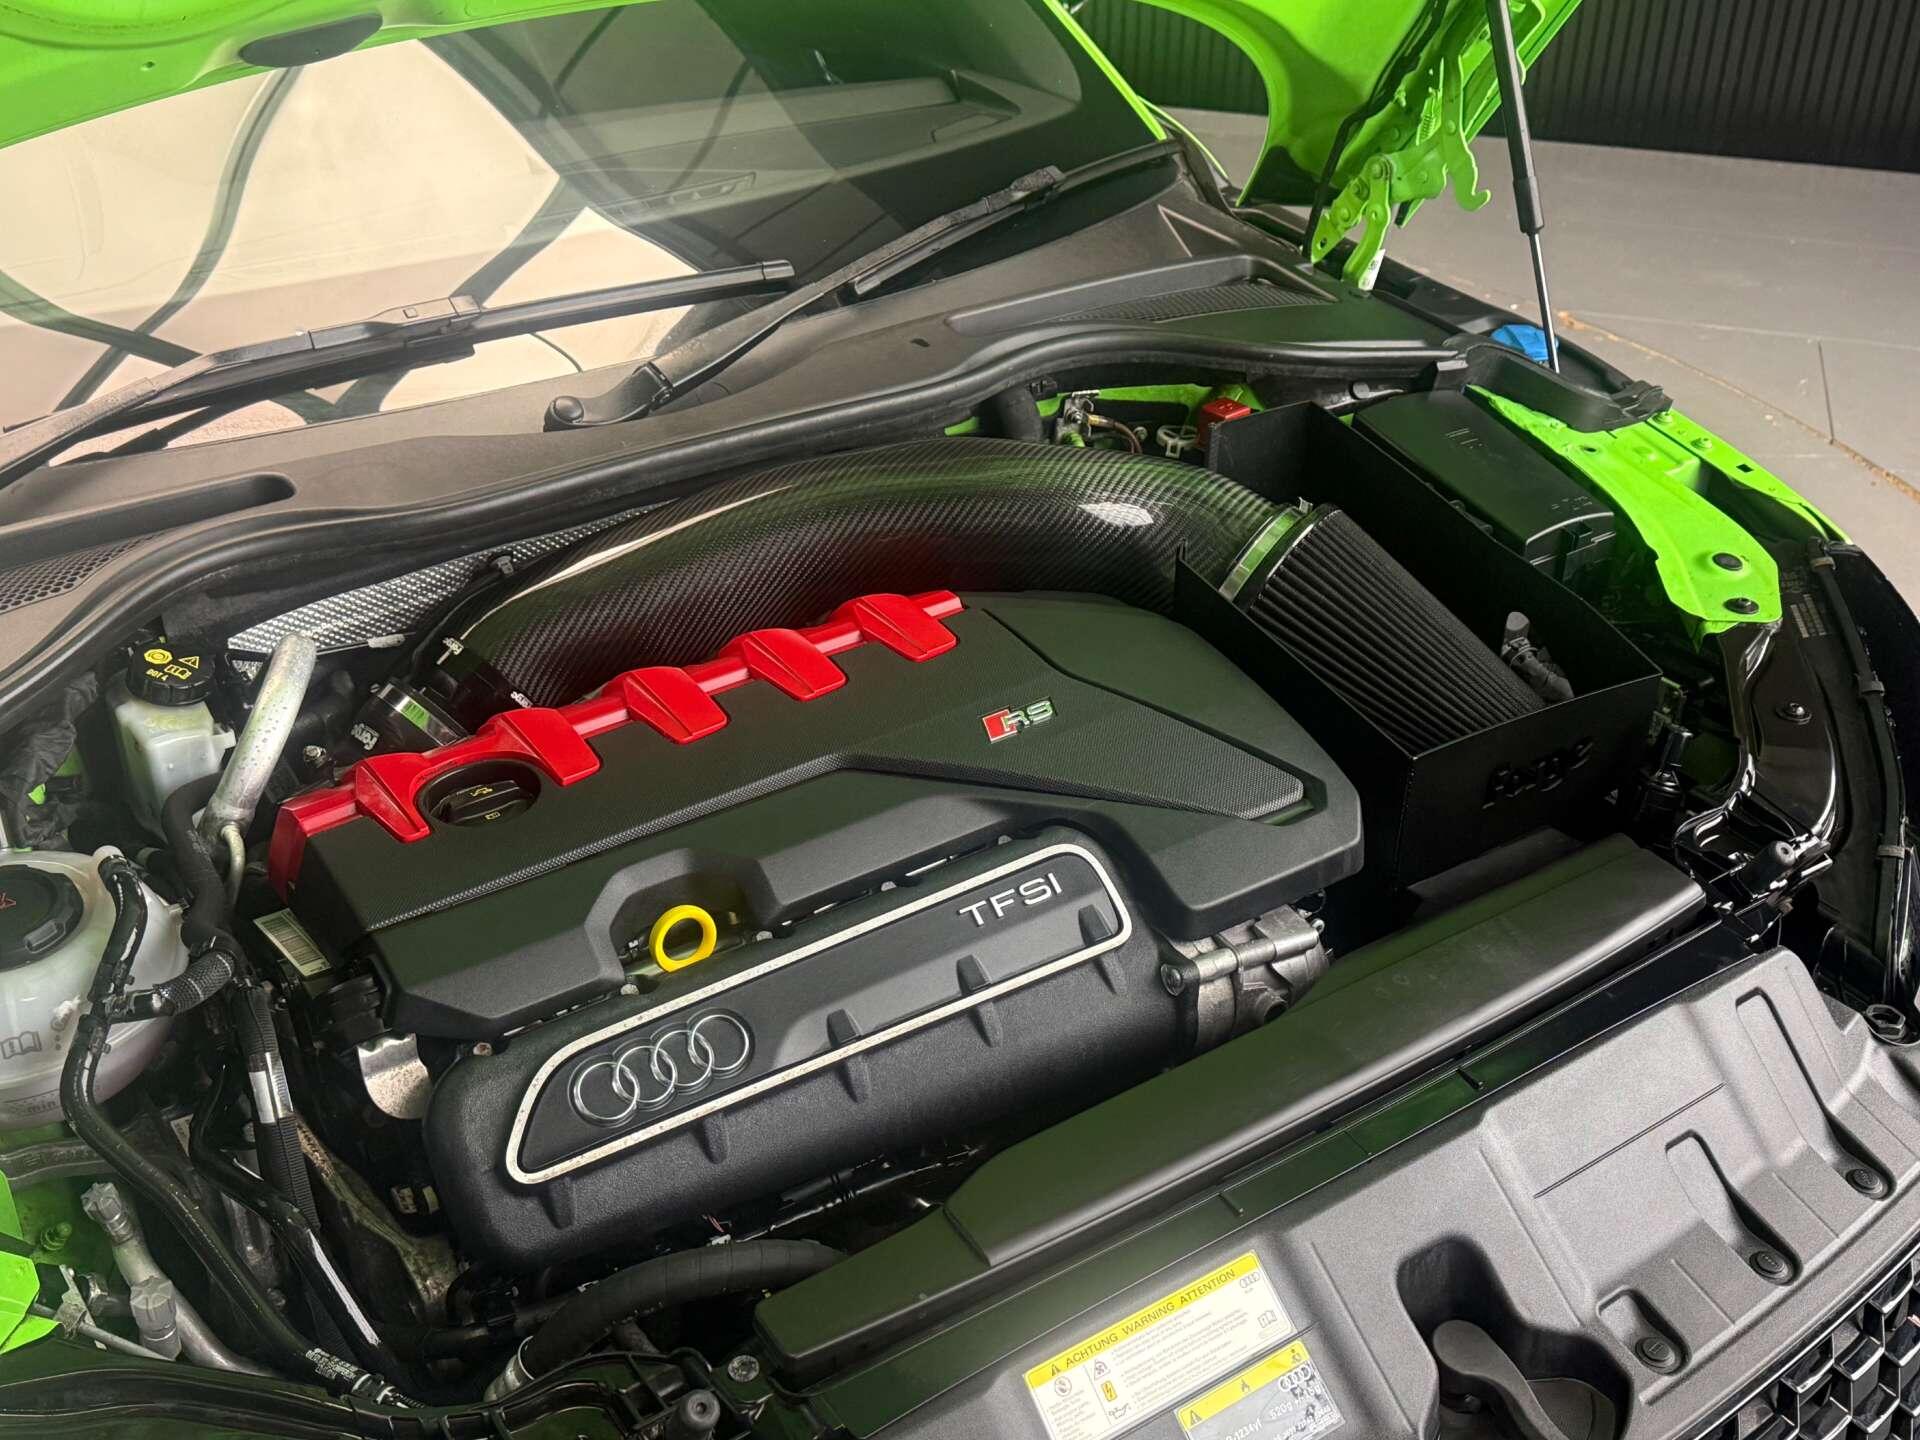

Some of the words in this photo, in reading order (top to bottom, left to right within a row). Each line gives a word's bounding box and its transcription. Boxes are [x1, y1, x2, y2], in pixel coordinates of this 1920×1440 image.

[999, 700, 1053, 732] RS
[958, 872, 1063, 927] TFSI
[27, 1099, 56, 1114] min
[1064, 1333, 1119, 1369] ACHTUNG
[1123, 1301, 1175, 1337] WARNING
[1179, 1268, 1236, 1305] ATTENTION
[1269, 1401, 1294, 1420] 520g
